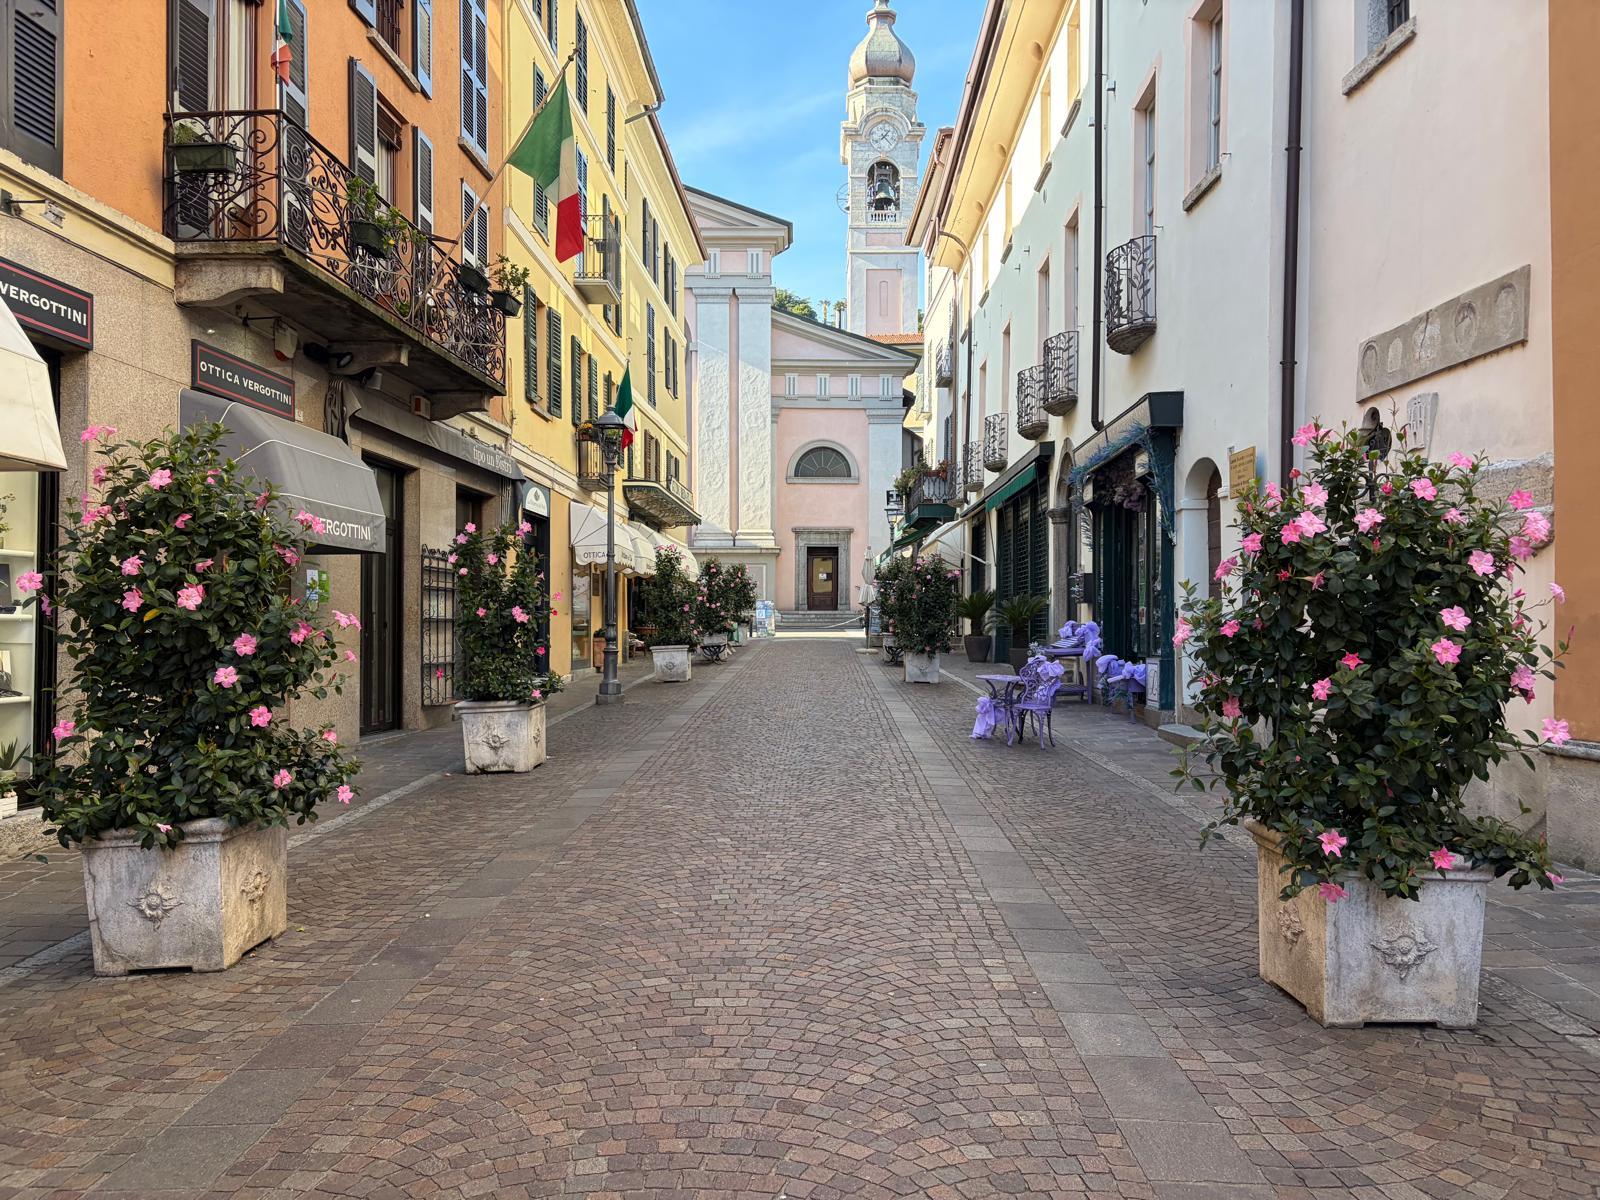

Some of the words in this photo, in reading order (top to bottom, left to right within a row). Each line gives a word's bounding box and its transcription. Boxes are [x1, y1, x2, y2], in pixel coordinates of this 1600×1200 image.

[0, 281, 87, 326] VERGOTTINI
[200, 361, 240, 385] OTTICA
[242, 377, 292, 406] VERGOTTINI
[473, 445, 486, 465] tipo
[486, 453, 495, 467] un
[317, 517, 371, 541] ERGOTTINI
[583, 551, 606, 559] OTTICA
